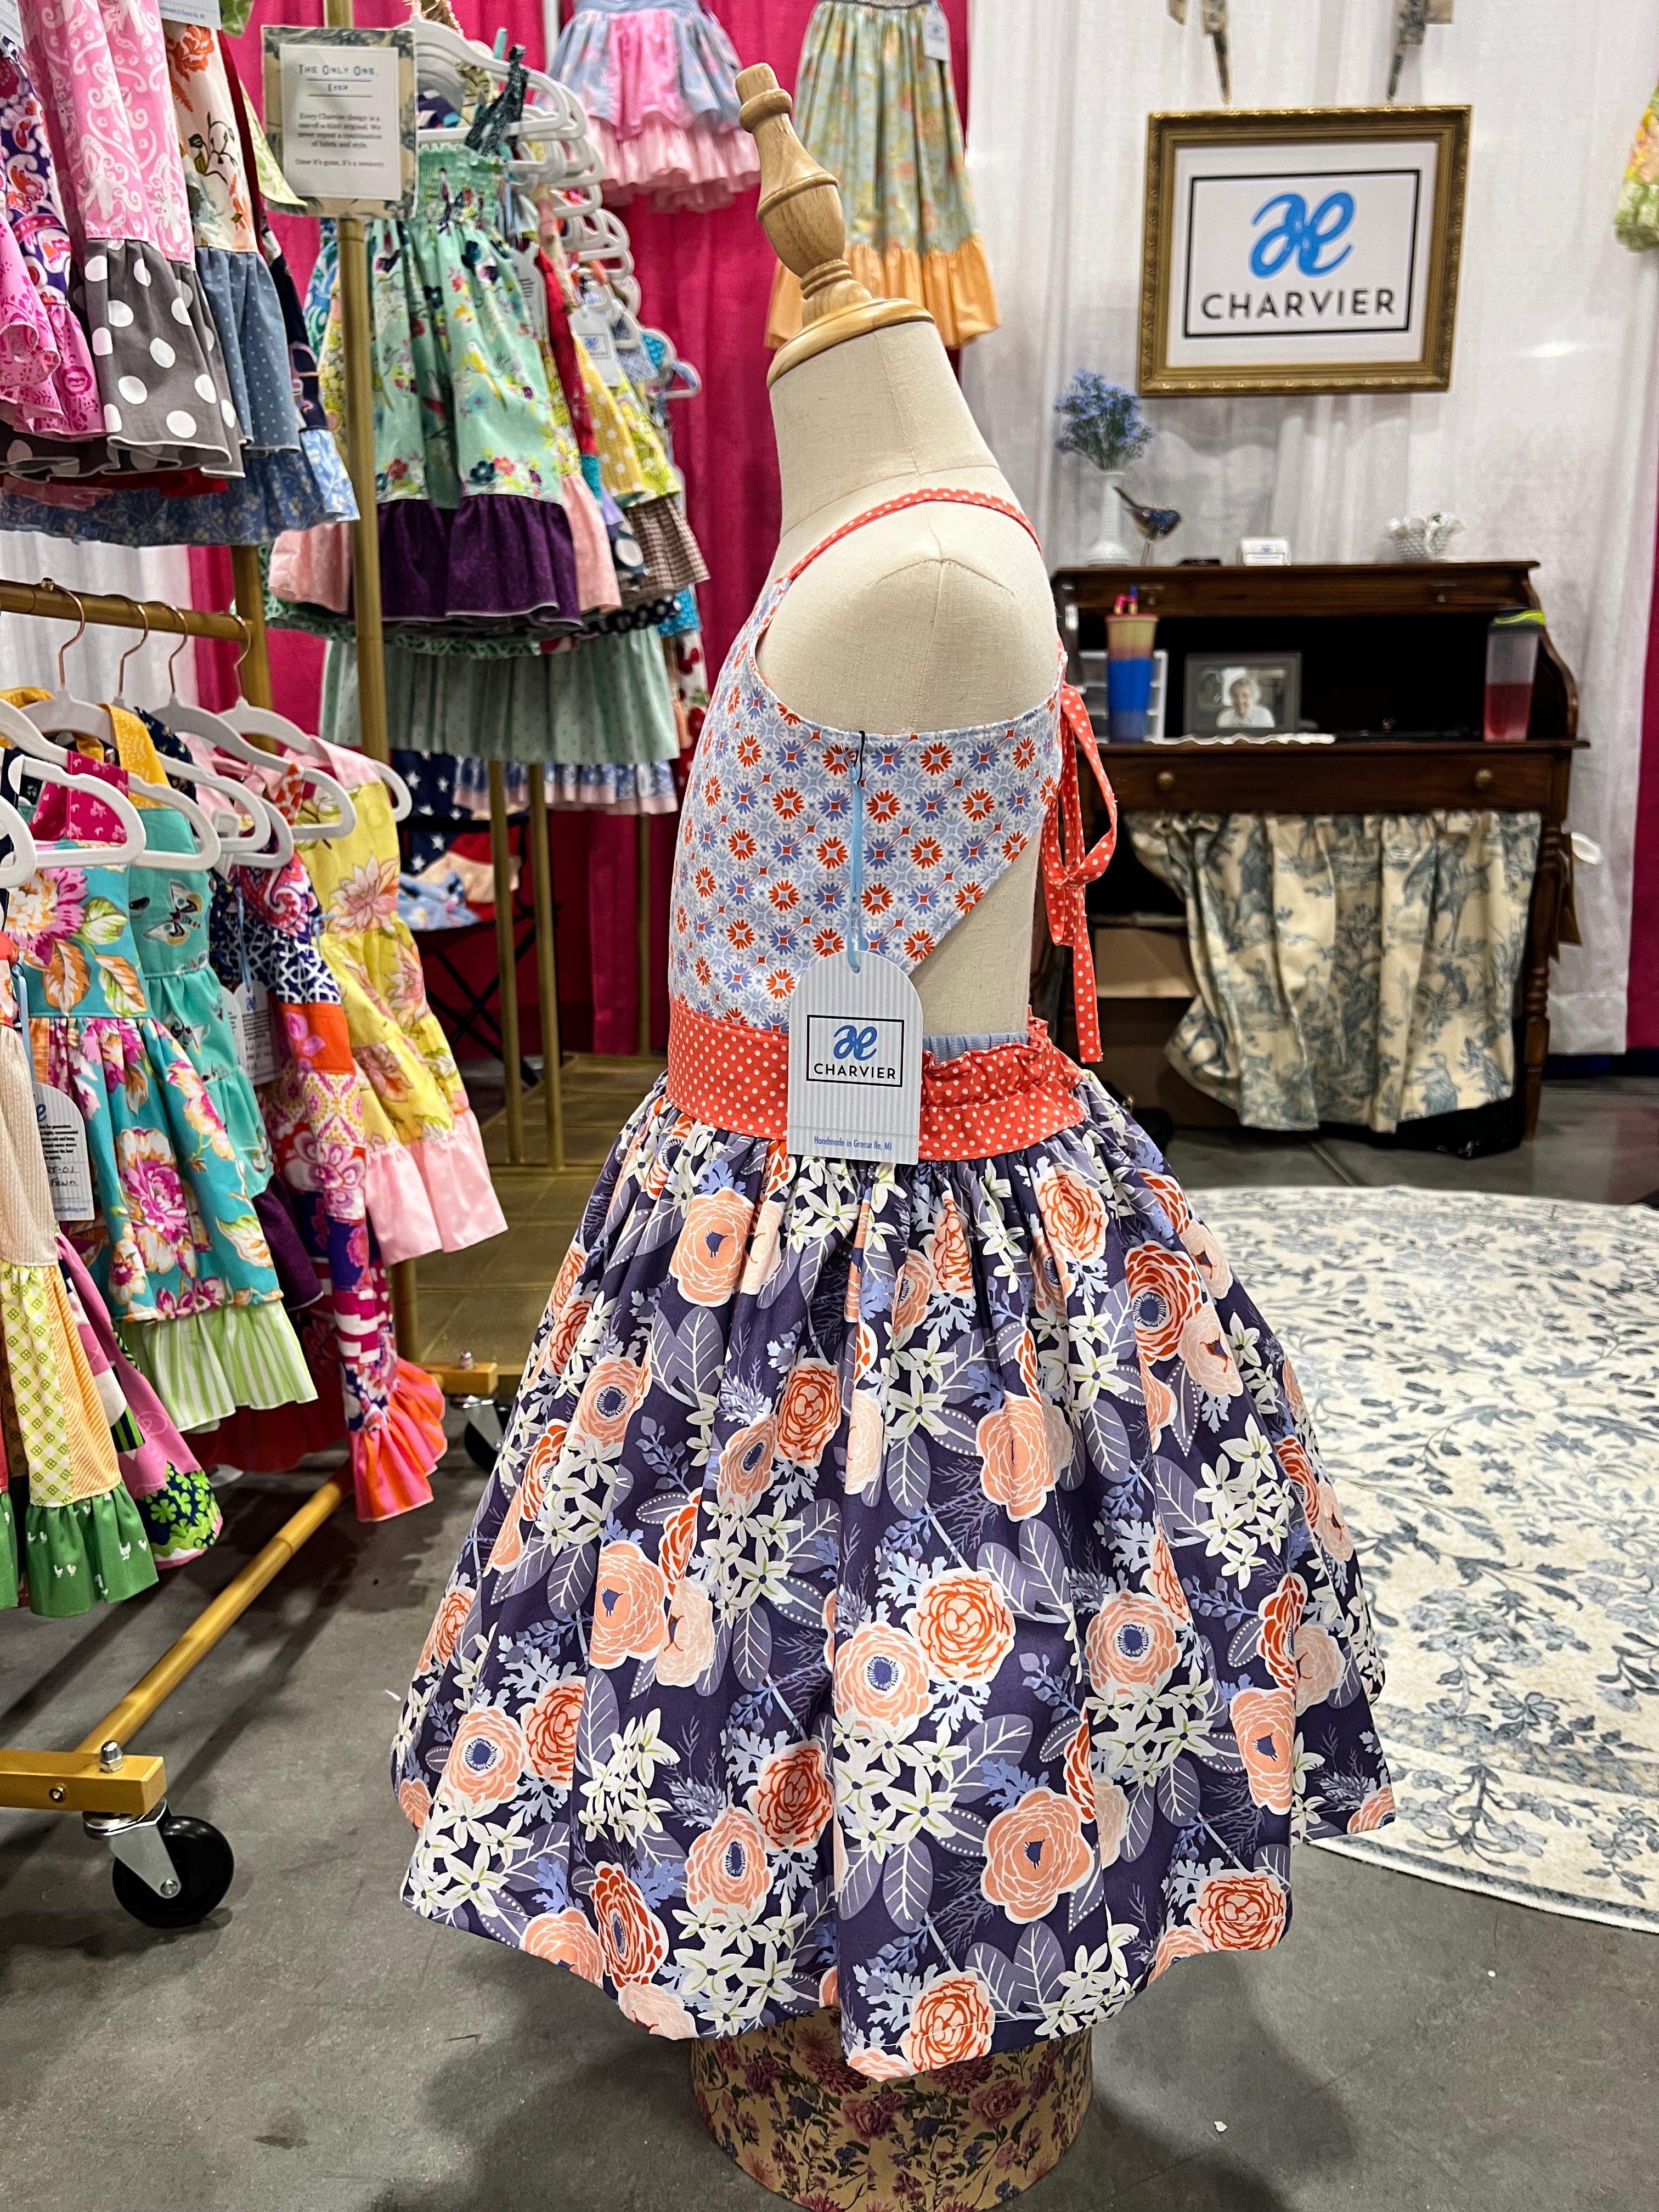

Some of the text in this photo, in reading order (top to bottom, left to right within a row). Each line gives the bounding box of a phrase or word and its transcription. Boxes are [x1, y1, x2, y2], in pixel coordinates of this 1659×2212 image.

[1201, 289, 1394, 319] CHARVIER
[814, 1063, 895, 1079] CHARVIER
[814, 1136, 845, 1147] Handmade
[846, 1139, 852, 1147] in
[854, 1139, 872, 1149] Grosse
[884, 1142, 892, 1150] MI
